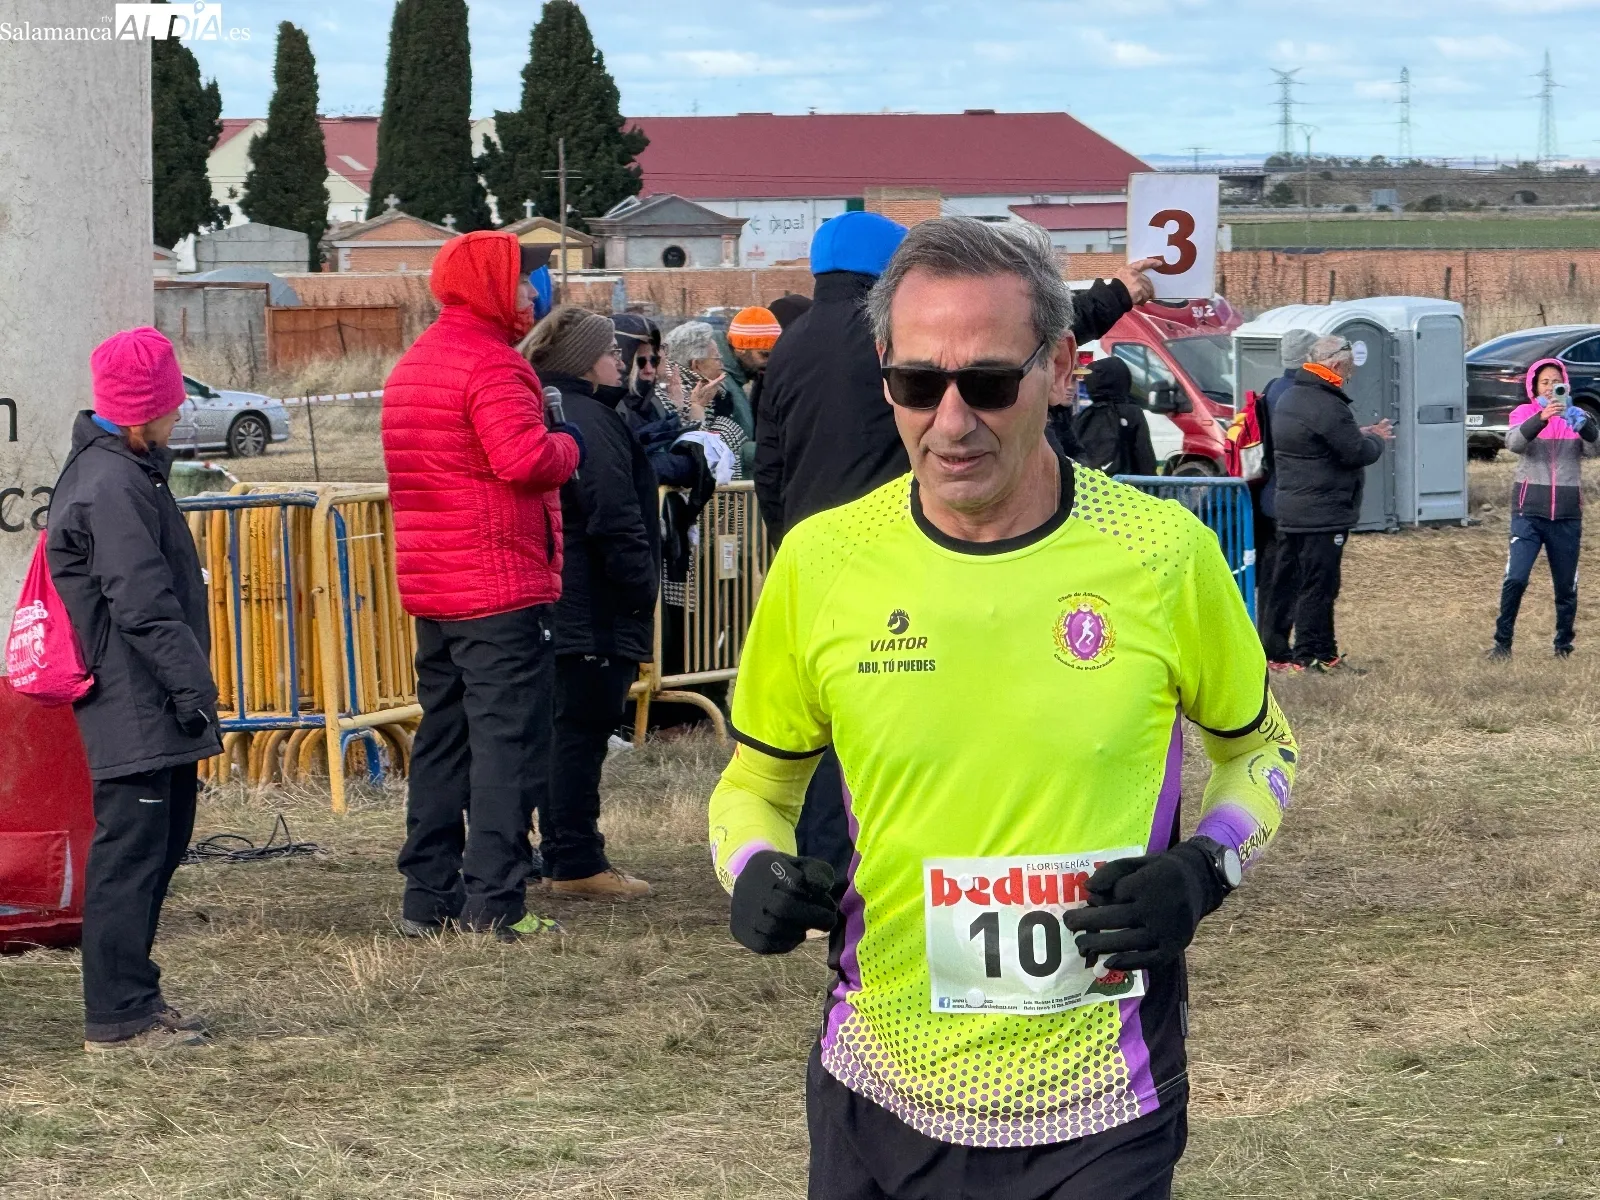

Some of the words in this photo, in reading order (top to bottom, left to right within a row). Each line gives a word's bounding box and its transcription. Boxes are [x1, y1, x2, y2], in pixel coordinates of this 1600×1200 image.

[1147, 208, 1198, 276] 3
[870, 636, 929, 653] VIATOR
[857, 661, 881, 675] ABU,
[882, 658, 896, 673] TÚ
[897, 659, 936, 673] PUEDES
[1026, 858, 1091, 872] FLORISTERÍAS
[930, 861, 1108, 907] bedun
[969, 909, 1100, 980] 10
